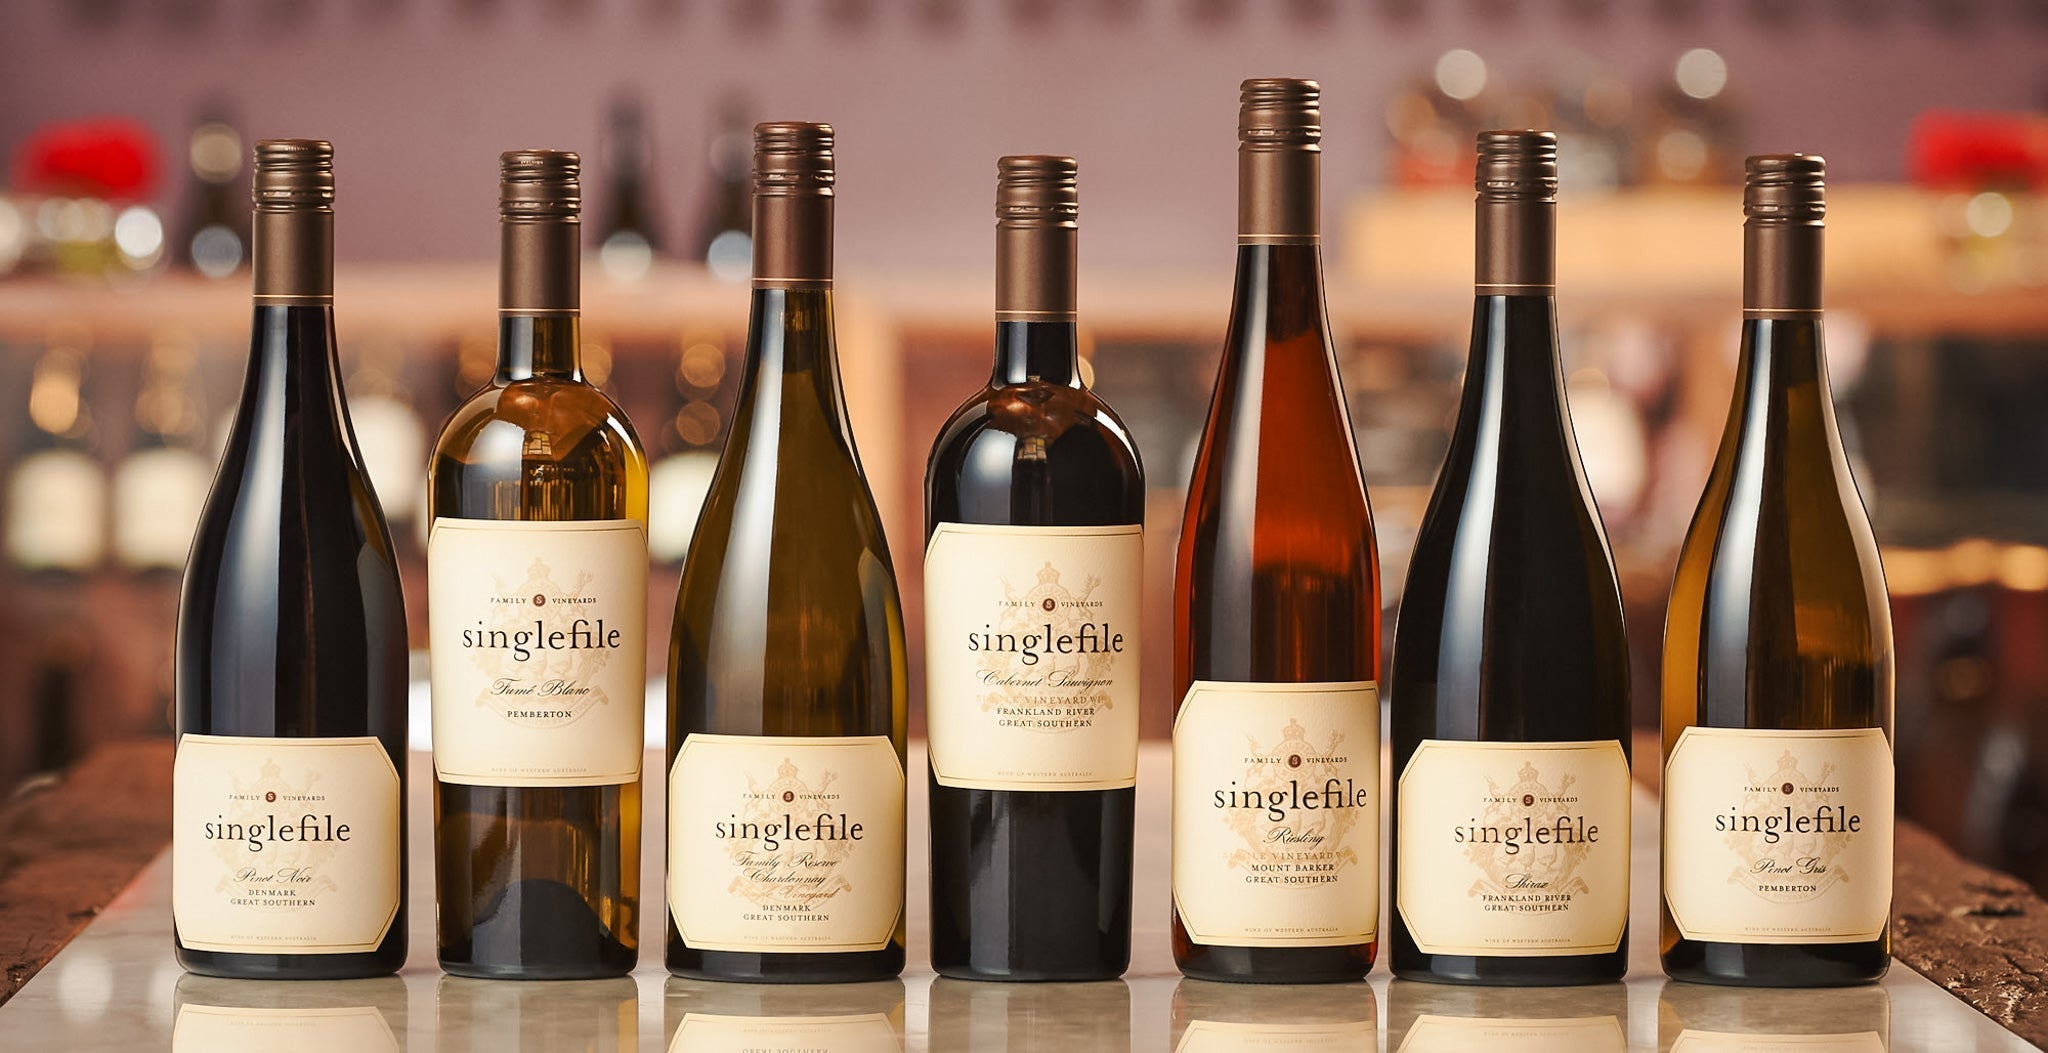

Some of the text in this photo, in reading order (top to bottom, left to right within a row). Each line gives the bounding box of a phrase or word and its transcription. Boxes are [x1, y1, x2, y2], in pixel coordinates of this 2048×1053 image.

[463, 619, 621, 662] singlefile
[968, 623, 1124, 666] singlefile
[490, 677, 590, 696] Fumé Blanc
[975, 669, 1113, 694] Cabernet Sauvignon
[1025, 696, 1087, 704] VINEYARD
[507, 710, 572, 718] PEMBERTON
[997, 707, 1062, 715] FRANKLAND
[998, 719, 1092, 728] GREAT SOUTHERN
[1214, 778, 1367, 822] singlefile
[716, 813, 864, 851] singlefile
[1716, 806, 1861, 844] singlefile
[205, 814, 351, 853] singlefile
[1263, 827, 1326, 850] Riesling
[1454, 816, 1599, 855] singlefile
[733, 851, 838, 870] Family Reserve
[1272, 852, 1333, 860] VINEYARD
[1252, 864, 1291, 872] MOUNT
[1750, 857, 1828, 875] Pinot Gris
[233, 867, 312, 883] Pinot Noir
[743, 868, 826, 889] Chardonnay
[1246, 875, 1338, 883] GREAT SOUTHERN
[1505, 873, 1549, 889] Shiraz
[248, 889, 297, 897] DENMARK
[263, 899, 316, 907] SOUTHERN
[762, 904, 811, 912] DENMARK
[1518, 904, 1569, 912] SOUTHERN
[743, 913, 774, 921] GREAT
